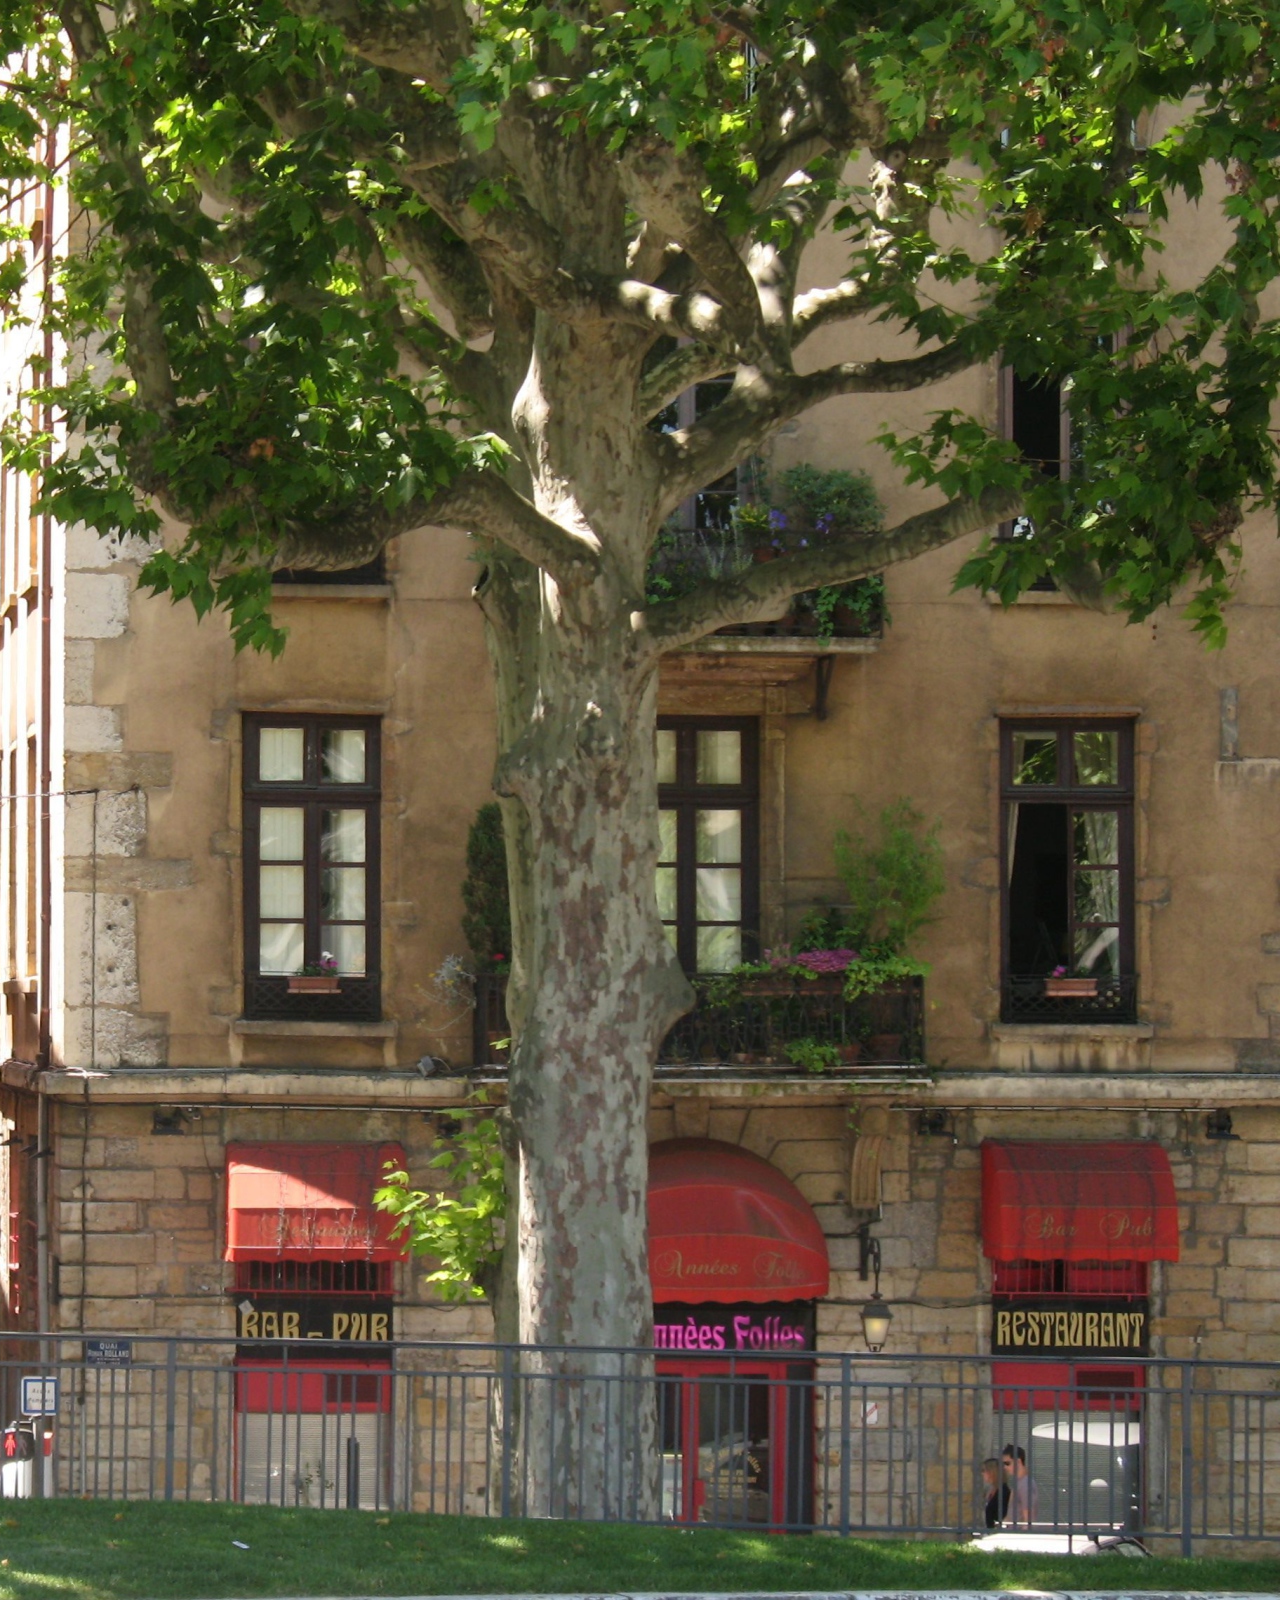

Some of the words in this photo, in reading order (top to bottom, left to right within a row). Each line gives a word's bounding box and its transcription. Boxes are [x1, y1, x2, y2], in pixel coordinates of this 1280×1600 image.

[1024, 1213, 1077, 1240] Bar
[1099, 1212, 1154, 1240] Pub
[654, 1249, 739, 1280] Années
[241, 1311, 301, 1347] BAR
[333, 1313, 389, 1348] PUB
[733, 1315, 806, 1350] Folles
[997, 1311, 1144, 1347] RESTAURANT
